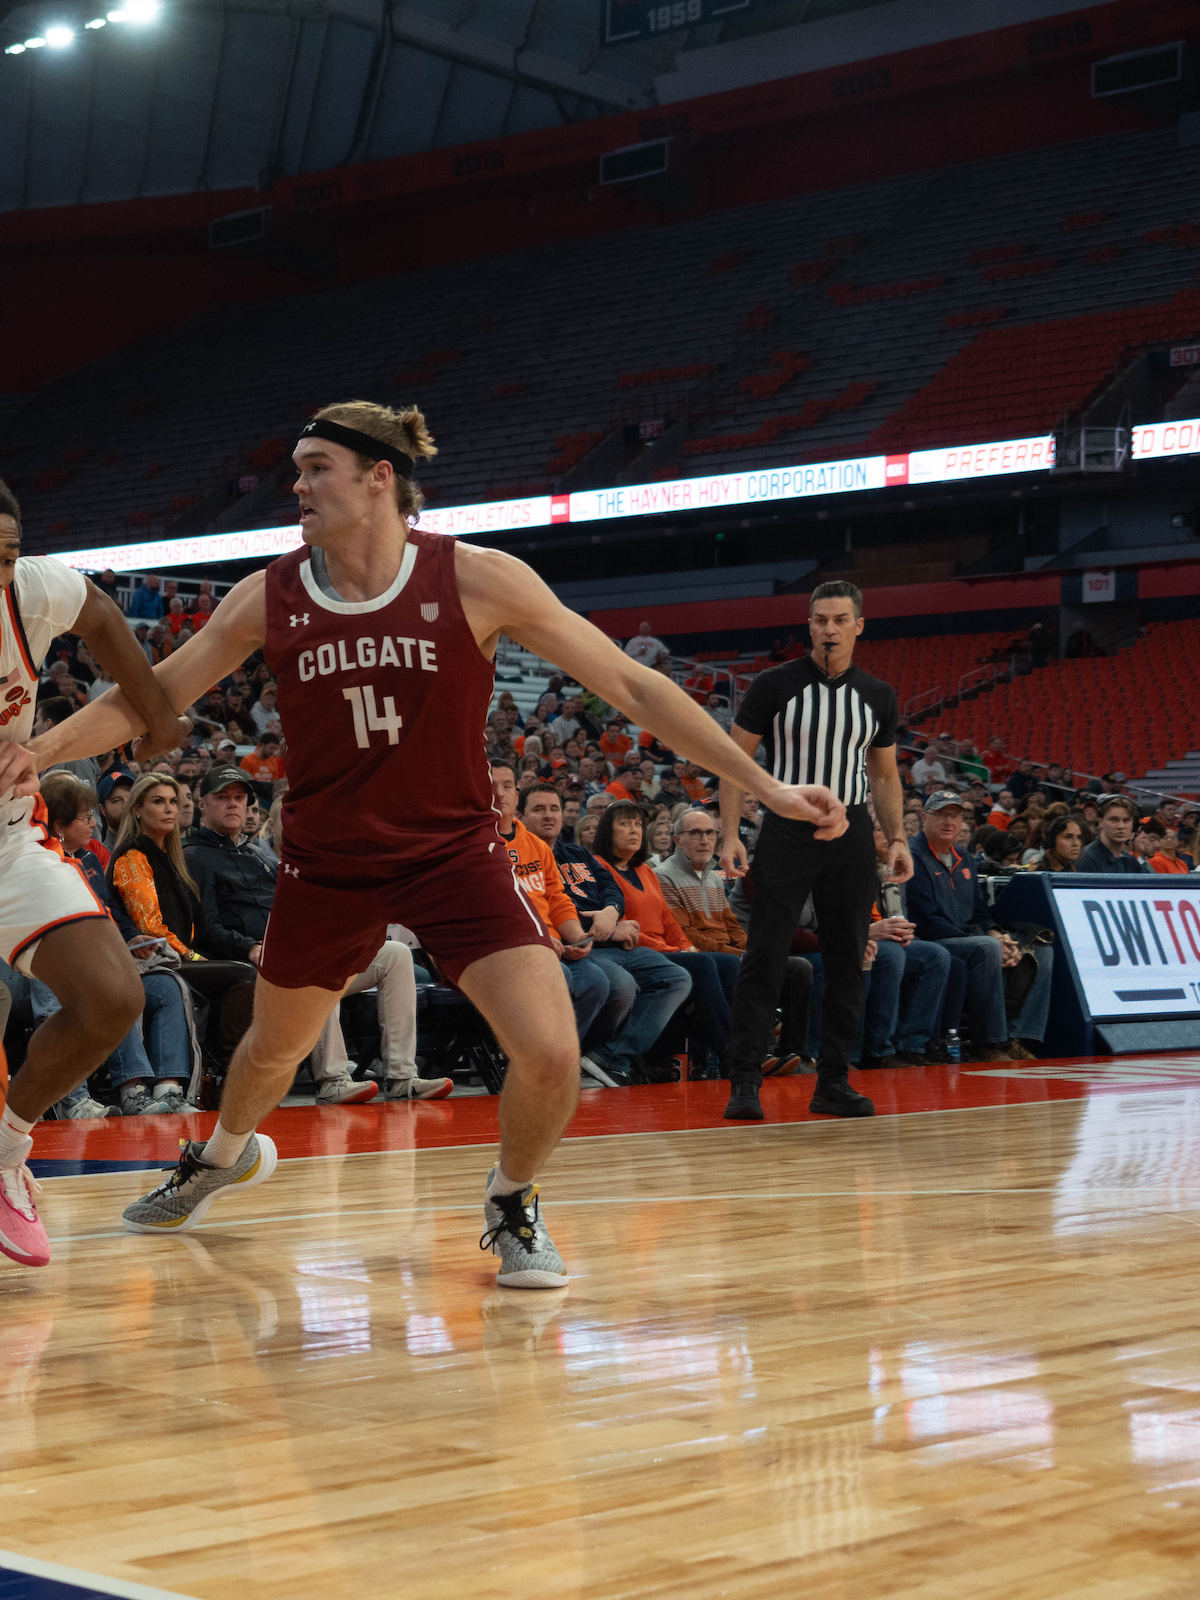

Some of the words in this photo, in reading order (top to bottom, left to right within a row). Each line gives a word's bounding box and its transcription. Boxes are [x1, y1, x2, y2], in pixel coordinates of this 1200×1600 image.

[647, 3, 701, 33] 1959
[596, 490, 625, 518] THE
[630, 483, 693, 513] HAYNER
[698, 477, 742, 505] HOYT
[746, 462, 868, 500] CORPORATION
[445, 503, 531, 531] ATHLETICS
[146, 536, 249, 565] CONSTRUCTION
[252, 528, 302, 554] COMPA
[298, 635, 439, 683] COLGATE
[342, 685, 403, 749] 14
[508, 848, 519, 864] S
